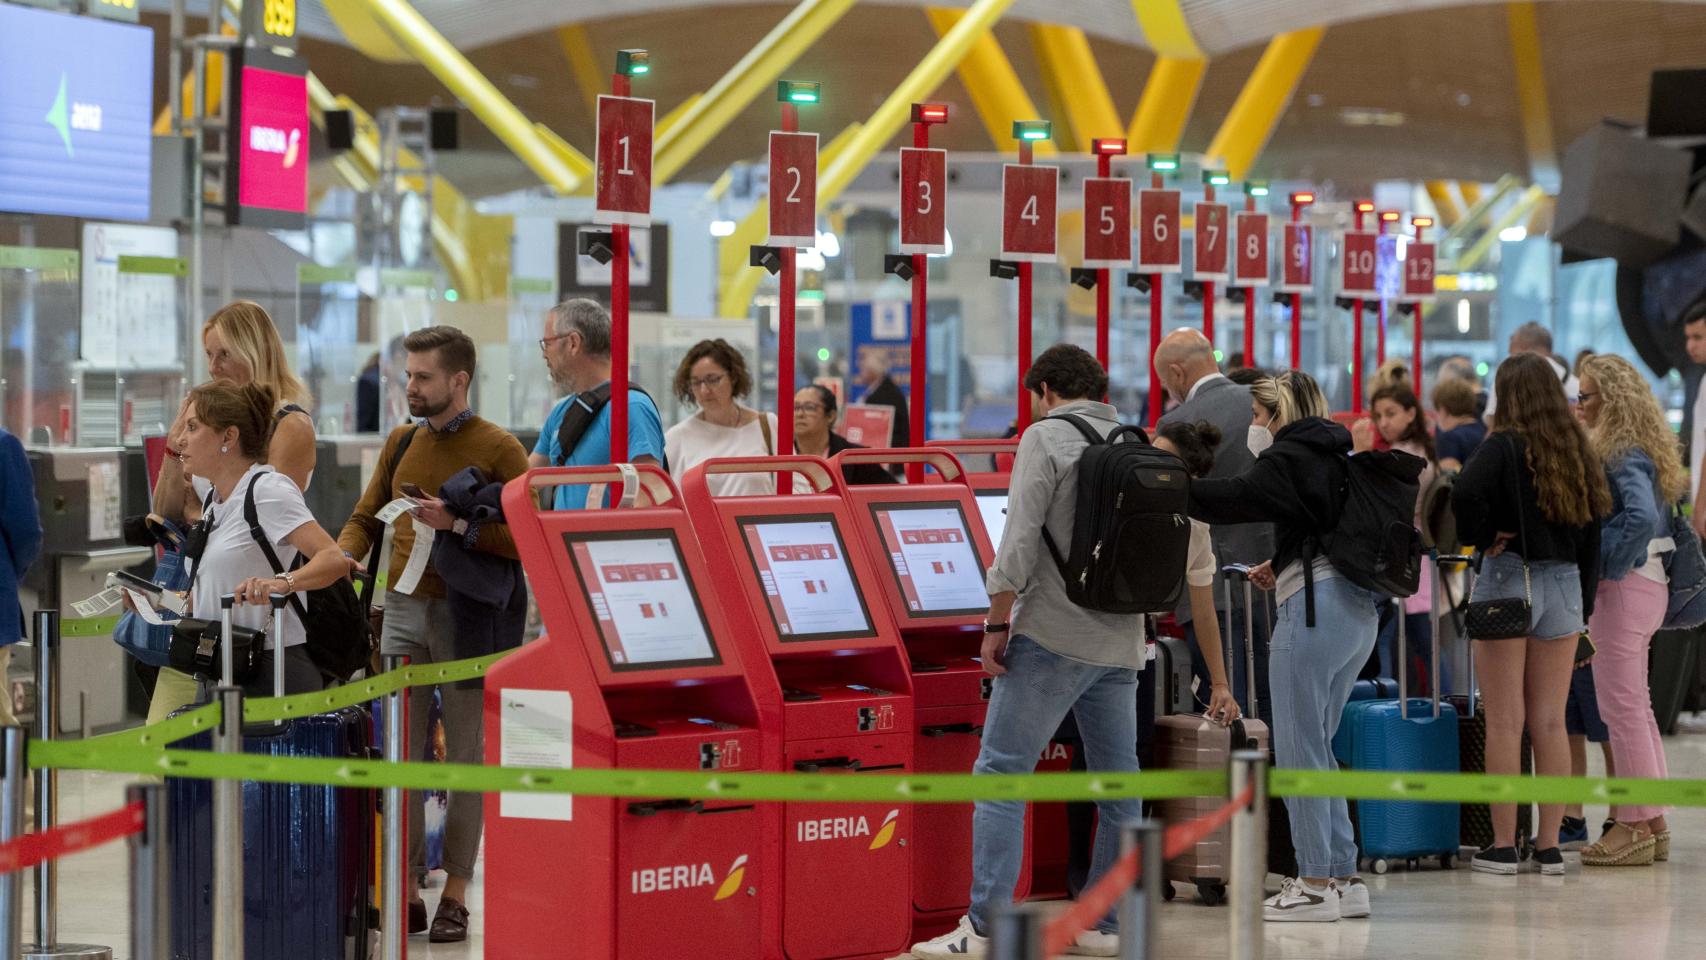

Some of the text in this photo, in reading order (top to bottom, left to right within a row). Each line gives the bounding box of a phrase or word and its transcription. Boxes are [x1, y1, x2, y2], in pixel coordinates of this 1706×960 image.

[617, 136, 634, 176] 1
[786, 167, 801, 203] 2
[917, 181, 932, 214] 3
[1020, 195, 1040, 226] 4
[1100, 206, 1115, 235] 5
[1153, 214, 1168, 242] 6
[1207, 226, 1219, 252] 7
[1246, 233, 1259, 259] 8
[1293, 246, 1304, 268] 9
[1348, 250, 1373, 274] 10
[1409, 258, 1433, 281] 12
[797, 815, 871, 842] IBERIA
[631, 862, 715, 895] IBERIA
